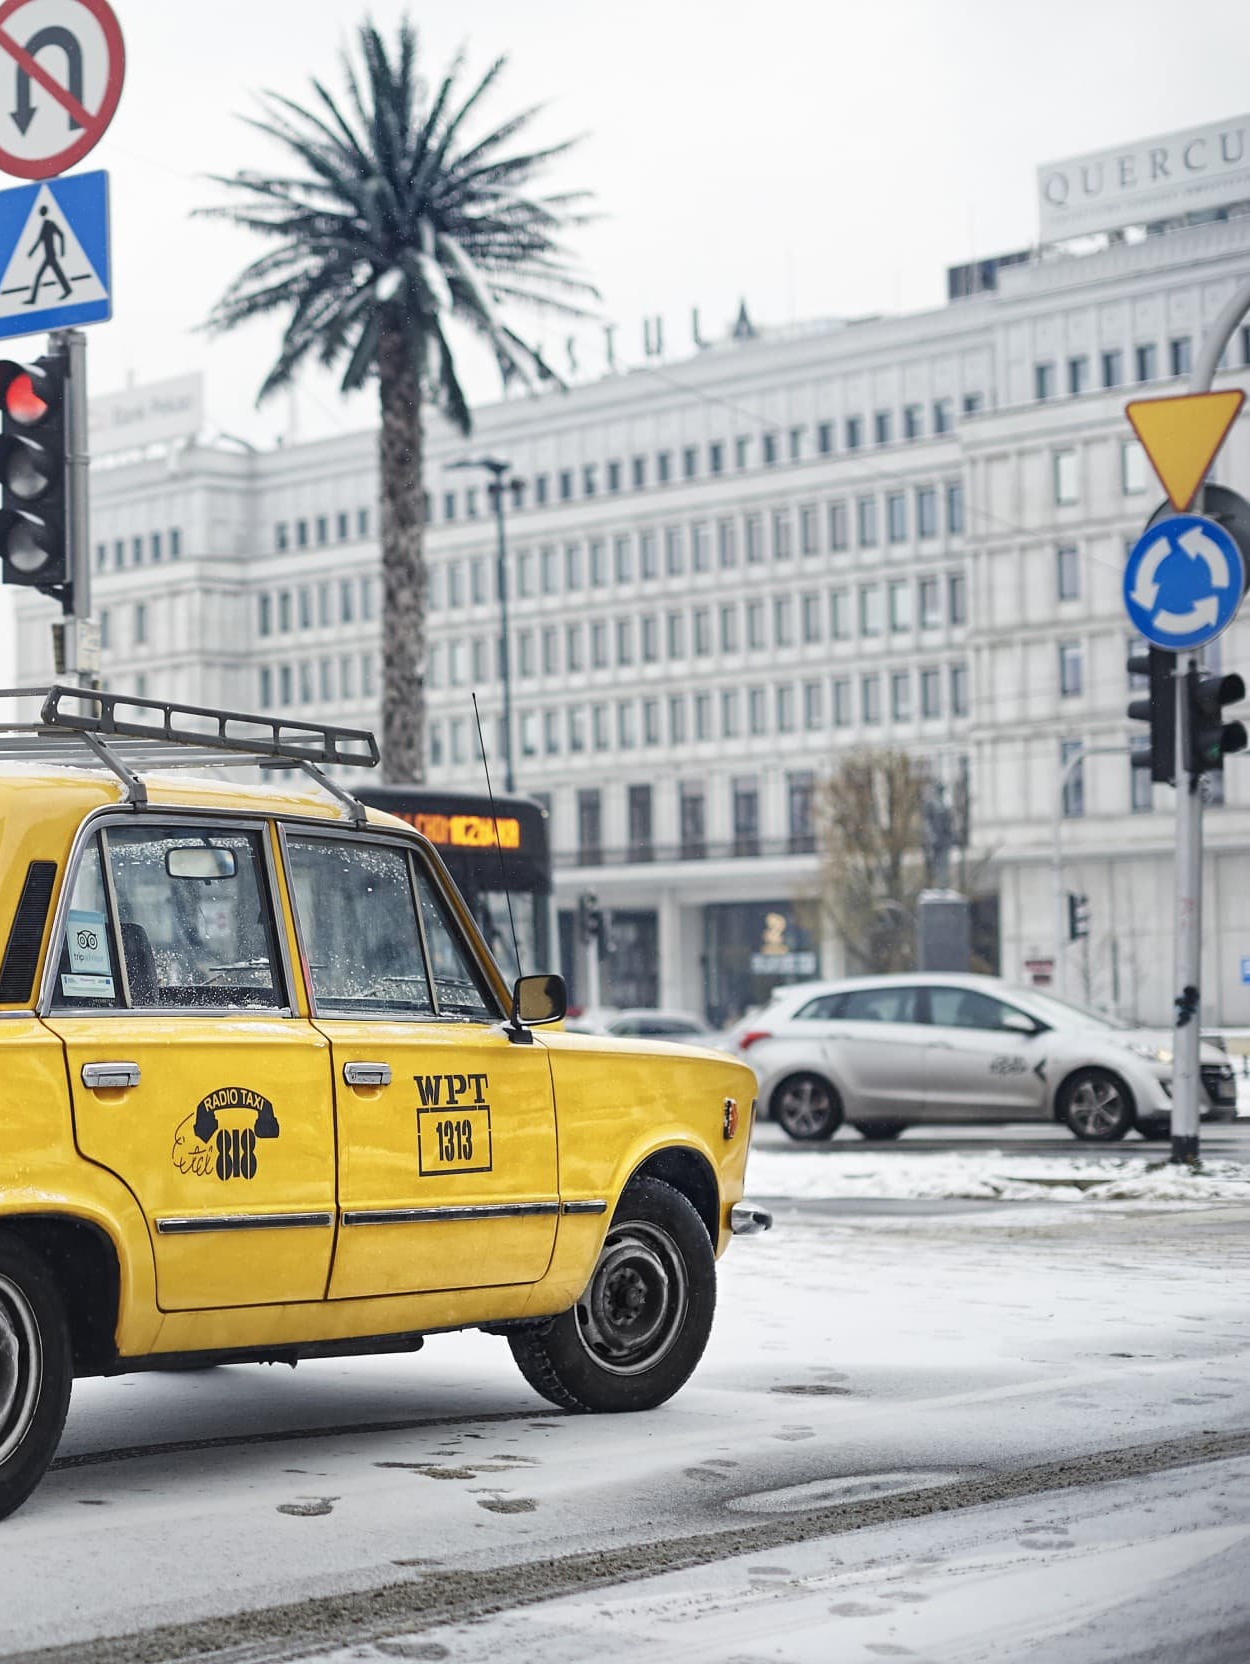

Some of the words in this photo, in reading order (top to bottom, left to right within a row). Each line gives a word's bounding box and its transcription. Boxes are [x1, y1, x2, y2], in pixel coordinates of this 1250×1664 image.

[535, 296, 758, 380] STULA
[203, 1088, 239, 1113] RADIO
[240, 1089, 265, 1111] TAXI
[413, 1074, 489, 1106] WPT
[436, 1119, 473, 1162] 1313
